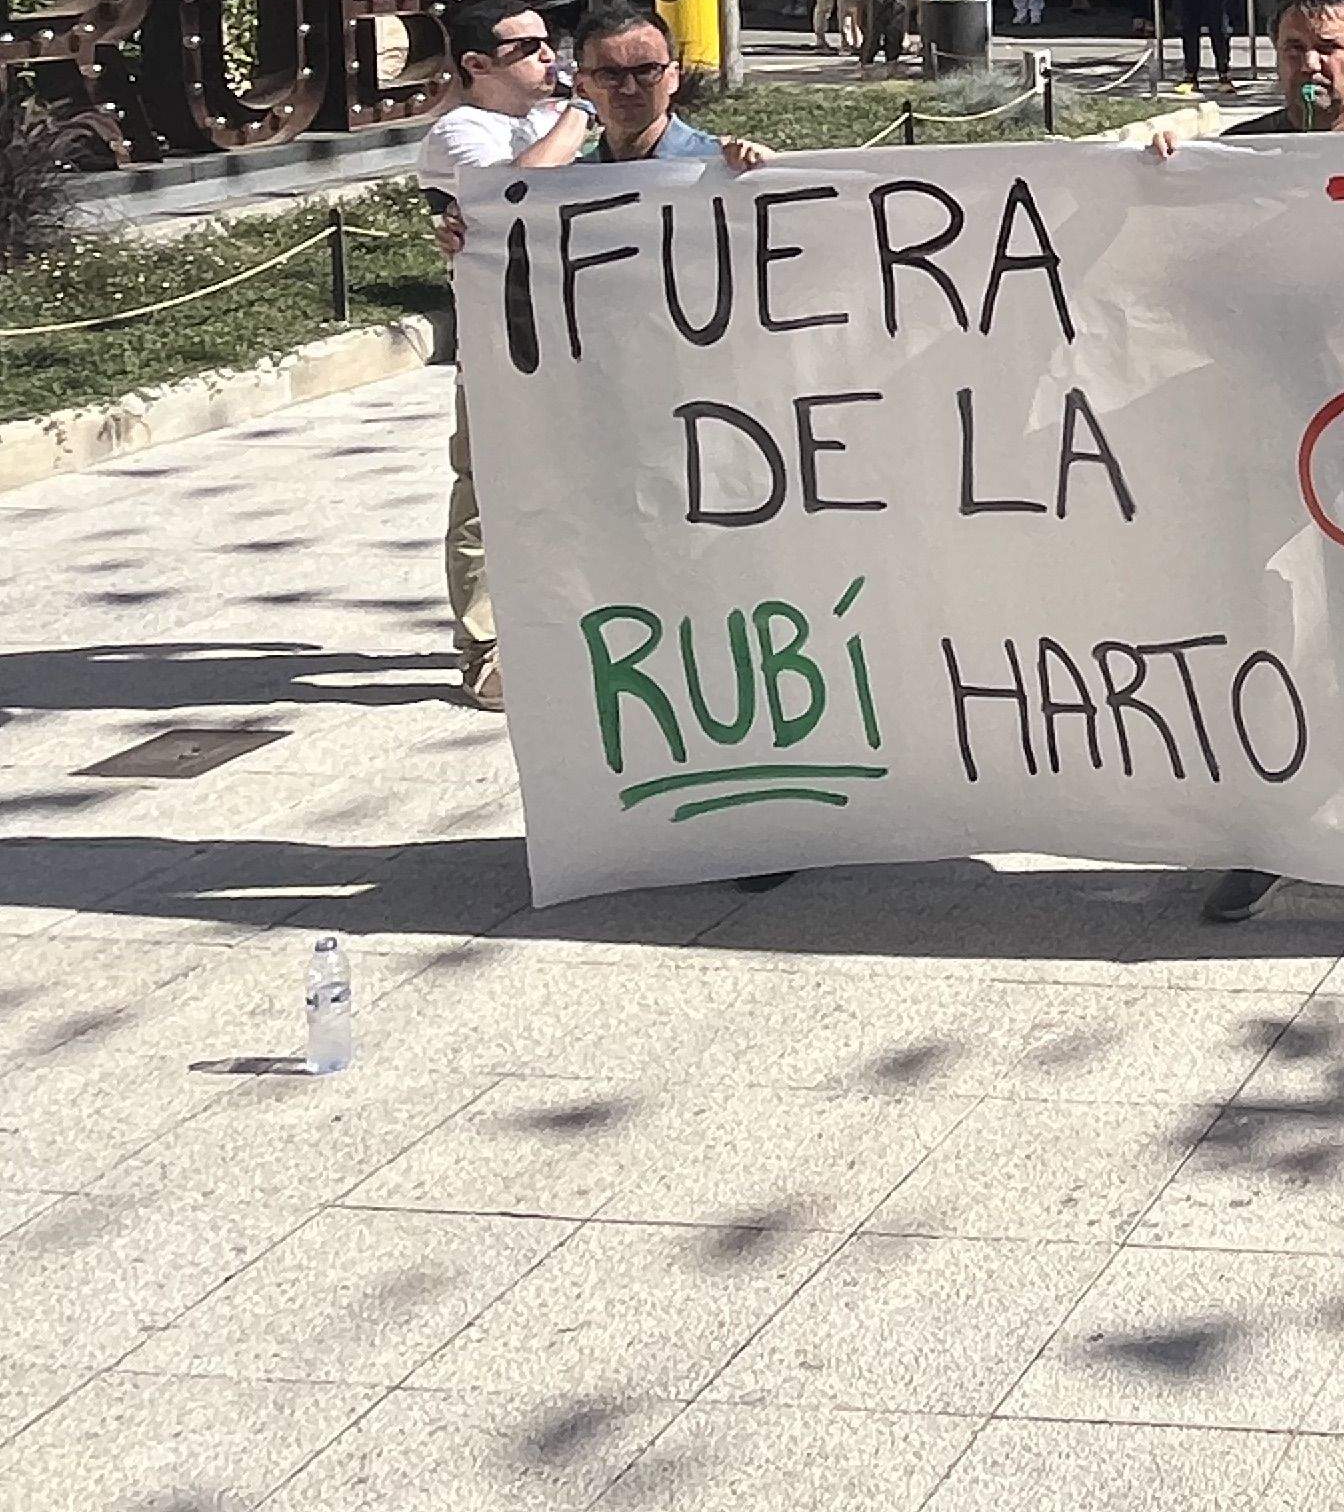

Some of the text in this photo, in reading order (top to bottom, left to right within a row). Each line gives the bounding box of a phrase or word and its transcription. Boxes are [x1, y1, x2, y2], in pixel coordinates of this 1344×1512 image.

[504, 176, 1076, 374] ¡FUERA
[672, 391, 887, 527] DE
[956, 386, 1137, 523] LA
[579, 575, 882, 774] RUBÍ
[942, 635, 1308, 784] HARTO
